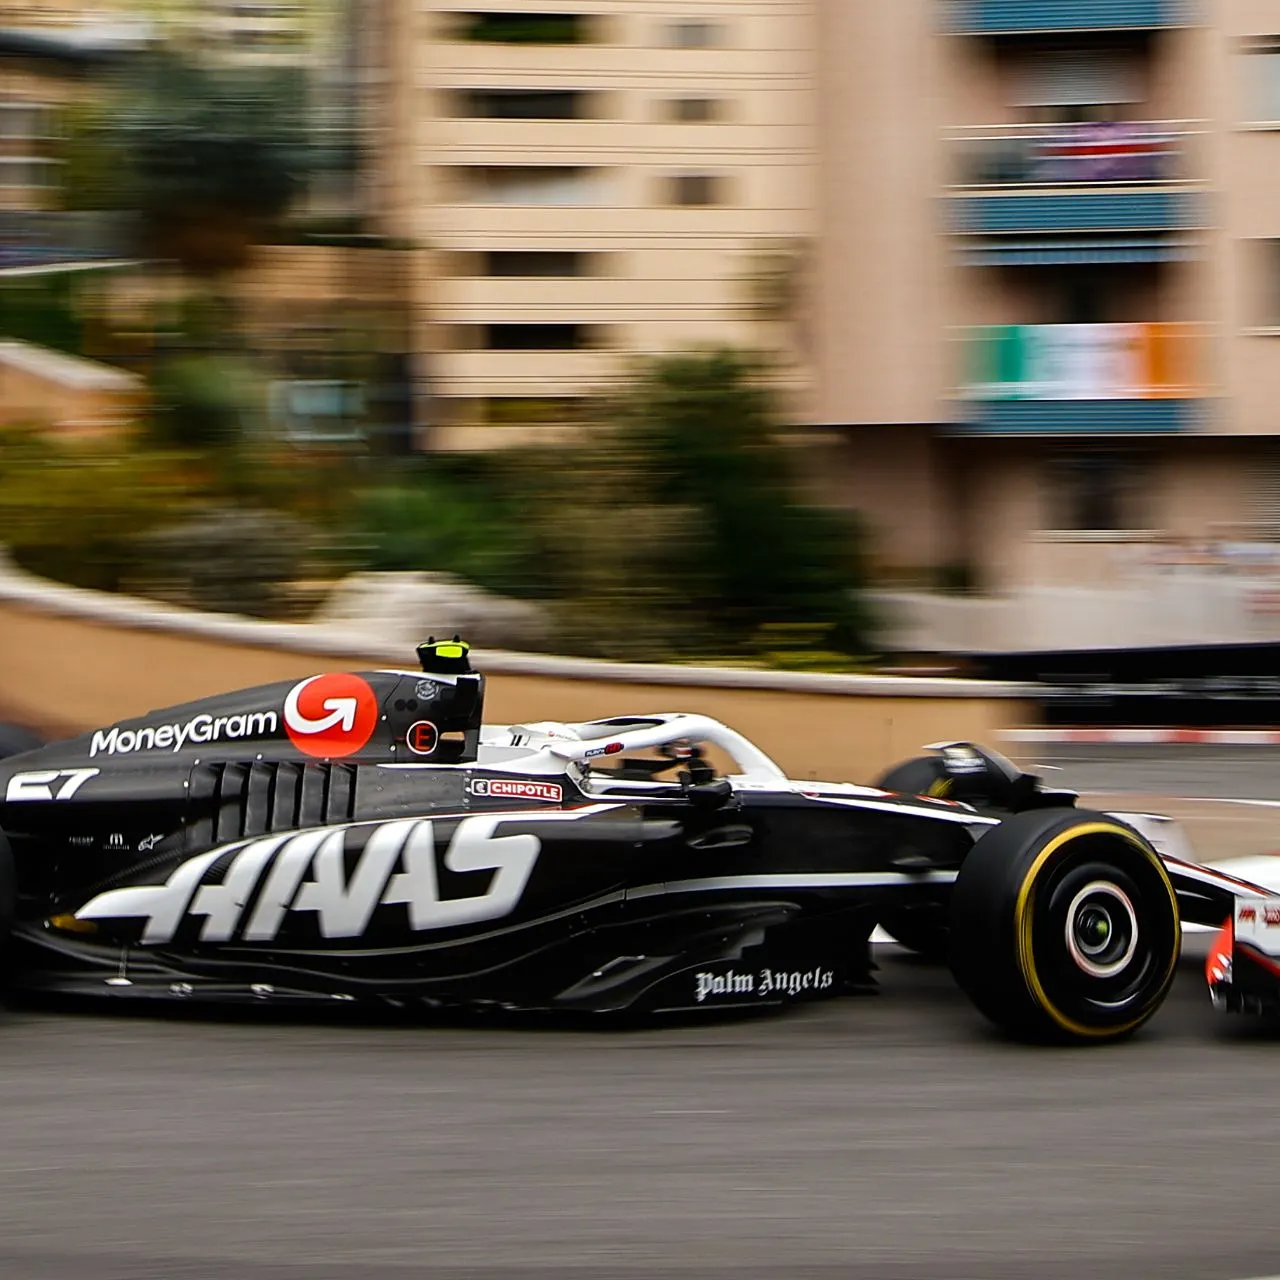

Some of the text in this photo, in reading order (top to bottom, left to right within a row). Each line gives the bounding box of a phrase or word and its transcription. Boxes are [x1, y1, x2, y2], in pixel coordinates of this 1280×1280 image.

[89, 710, 278, 758] MoneyGram
[415, 724, 432, 751] E
[491, 782, 559, 799] CHIPOTLE
[76, 815, 542, 945] HAAS
[694, 965, 834, 1002] Palm Angels
